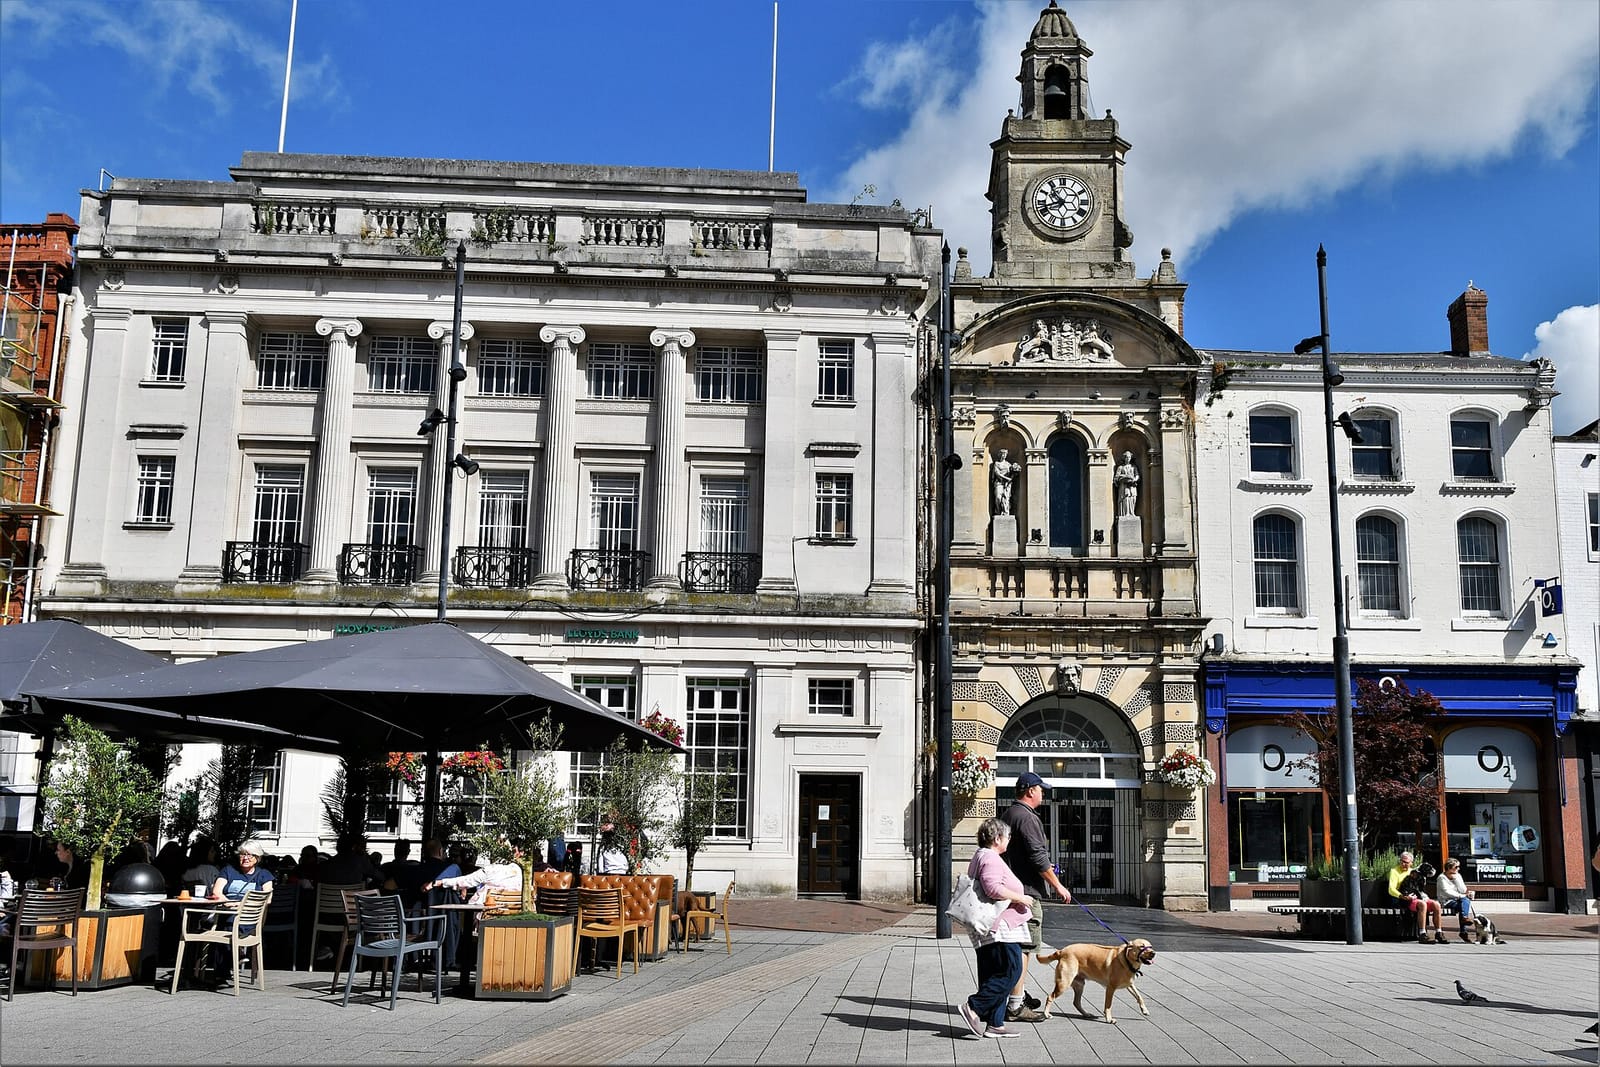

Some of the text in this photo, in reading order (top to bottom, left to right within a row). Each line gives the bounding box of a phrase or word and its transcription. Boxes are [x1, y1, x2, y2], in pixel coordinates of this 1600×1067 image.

[335, 624, 377, 634] LLOYDS
[567, 629, 639, 639] LLOYDS BANK
[1018, 739, 1076, 748] MARKET
[1477, 744, 1512, 778] O2
[1260, 864, 1288, 873] Roam
[1477, 864, 1504, 873] Roam
